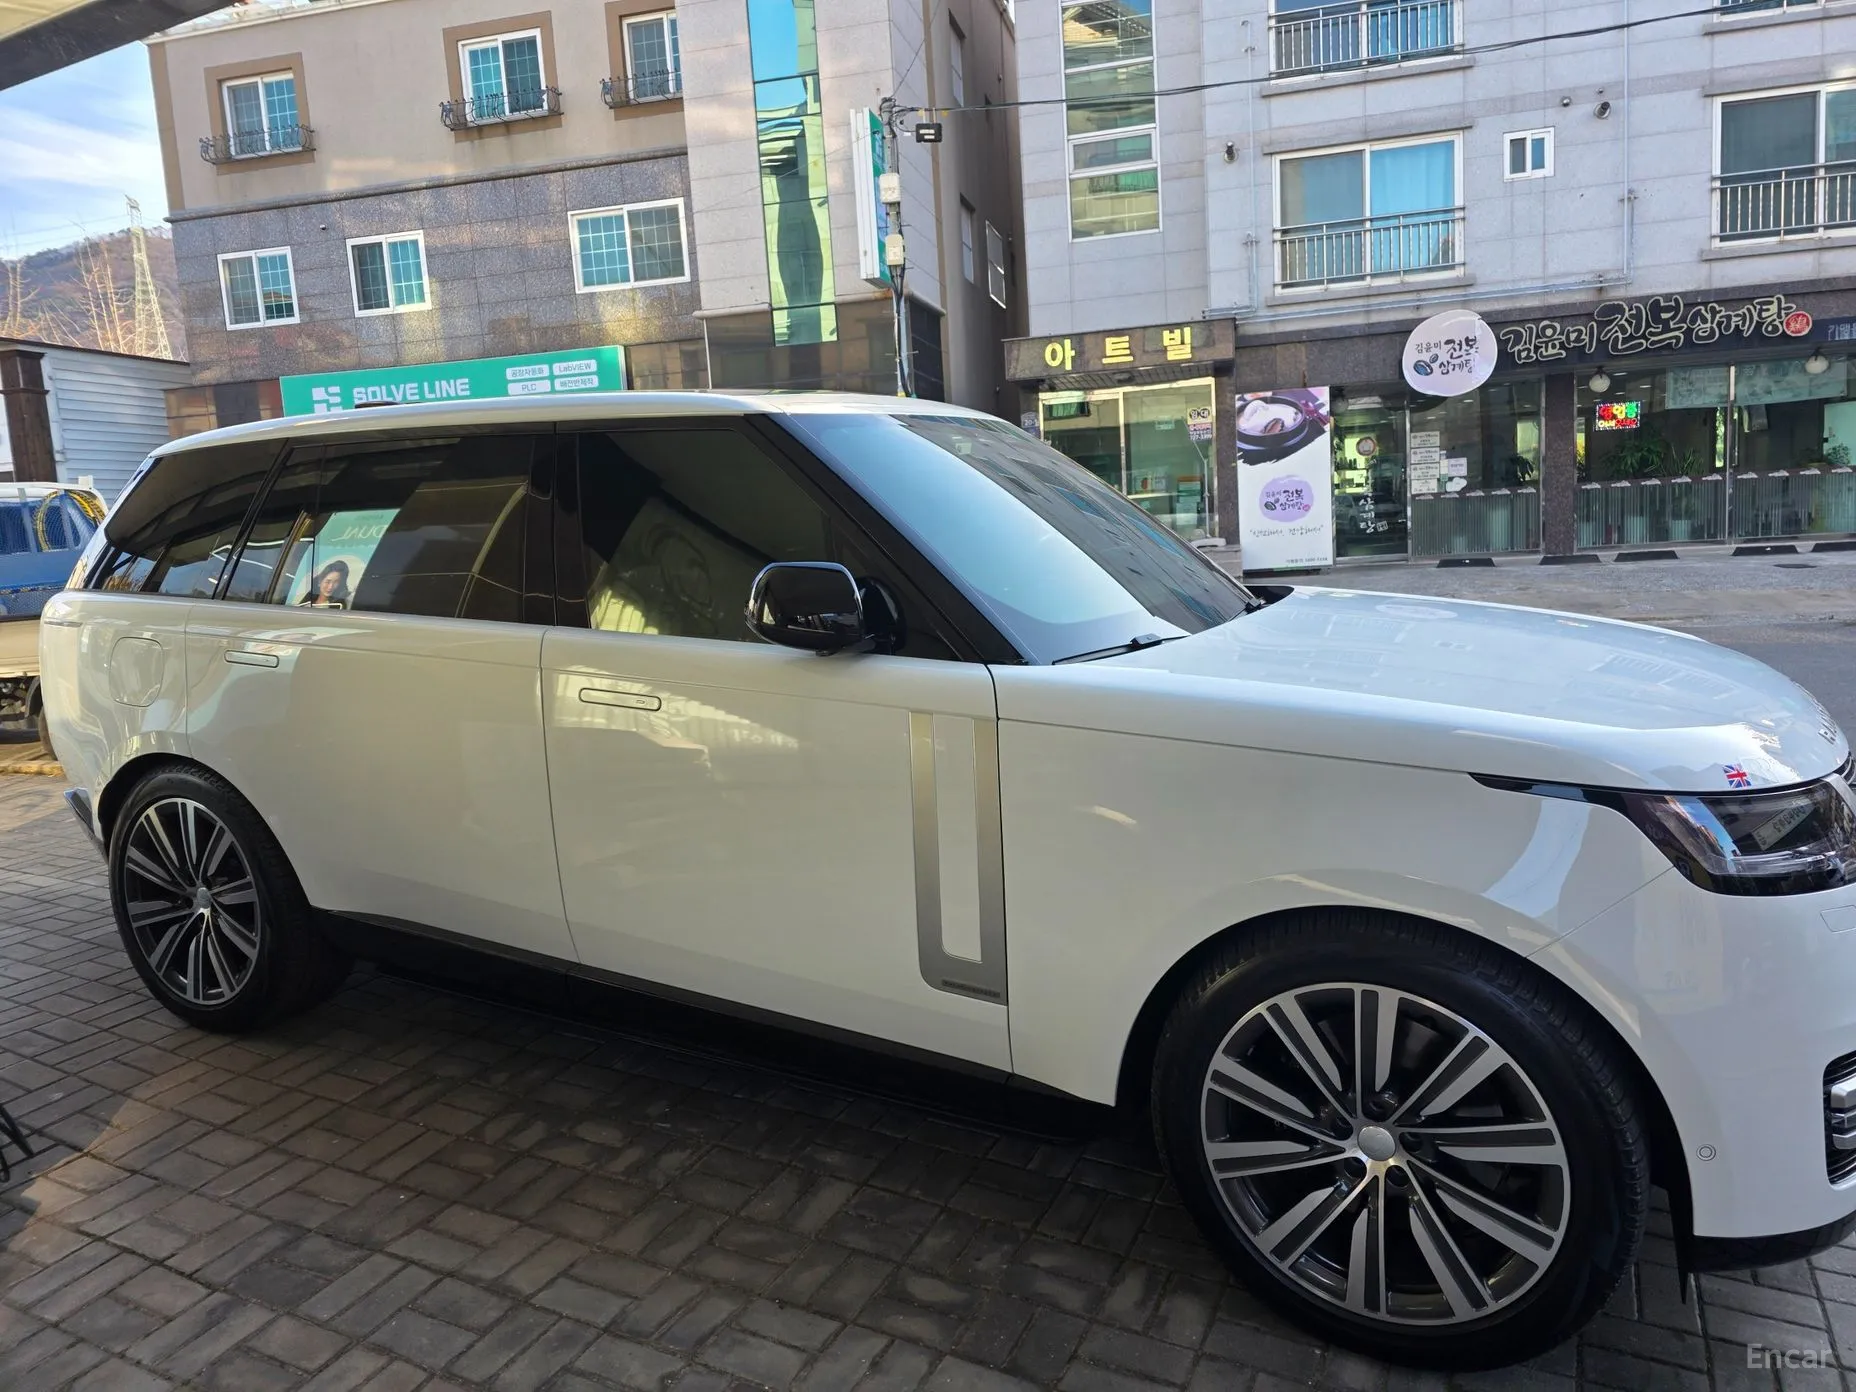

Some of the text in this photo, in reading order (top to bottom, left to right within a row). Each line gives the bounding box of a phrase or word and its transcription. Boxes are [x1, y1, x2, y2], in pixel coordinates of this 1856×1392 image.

[1499, 294, 1796, 363] 김윤미 전복 삼계탕
[1044, 326, 1193, 371] 아트빌
[1415, 341, 1442, 354] 김윤미
[353, 377, 471, 405] SOLVE LINE
[521, 383, 537, 392] PLC
